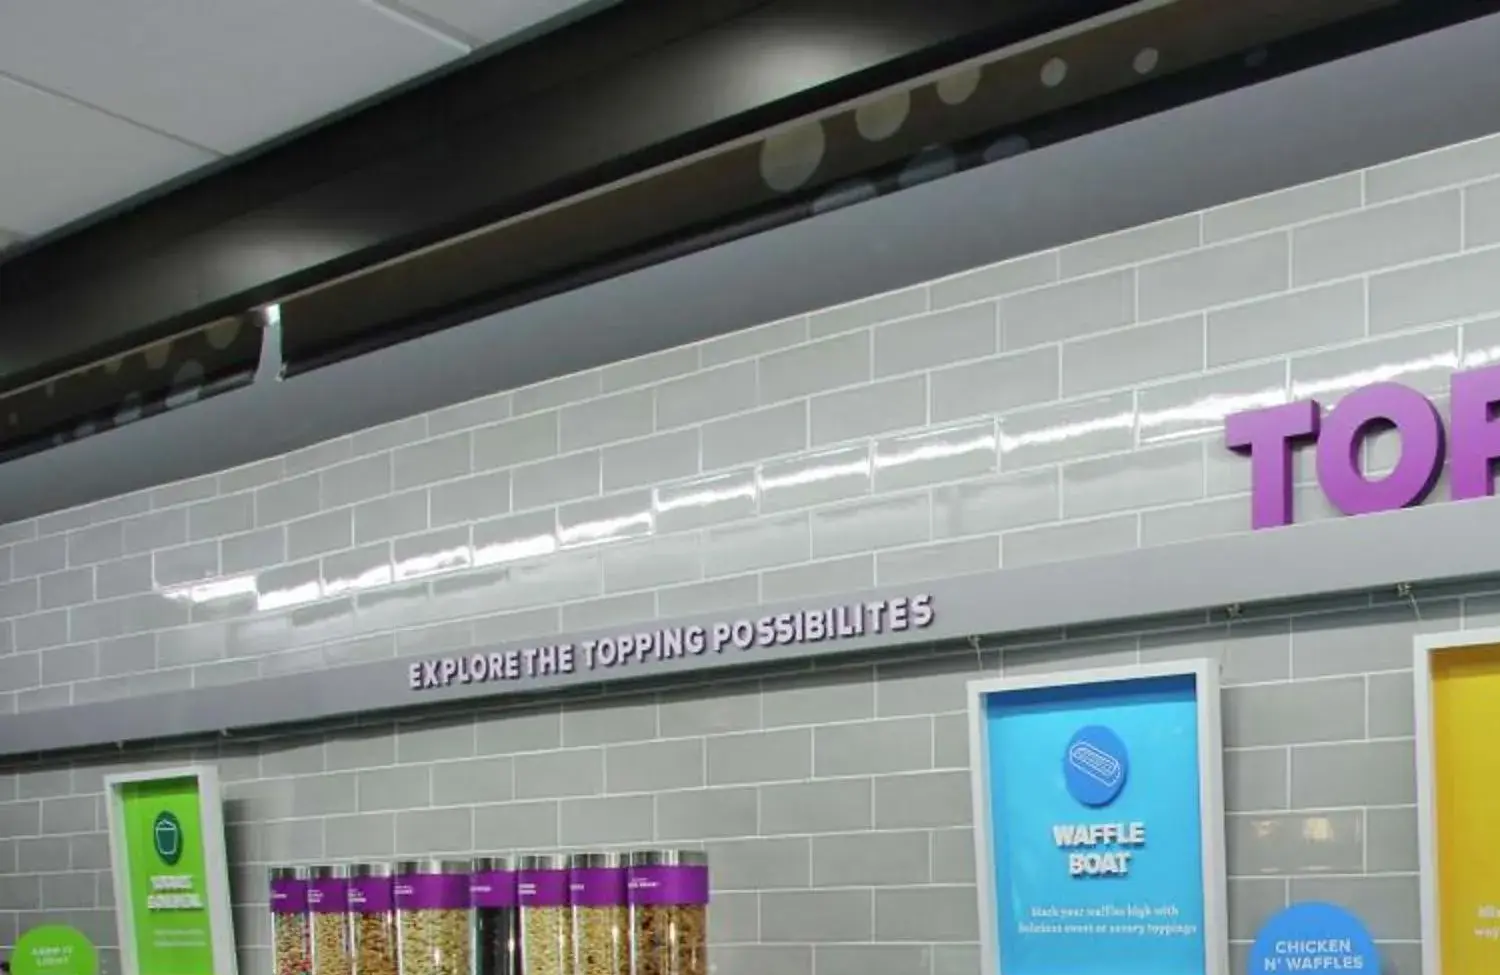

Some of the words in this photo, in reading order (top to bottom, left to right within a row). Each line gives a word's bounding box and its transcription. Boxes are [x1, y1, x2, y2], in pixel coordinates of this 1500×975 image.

[409, 651, 521, 690] EXPLORE
[523, 644, 575, 677] THE
[581, 626, 706, 671] TOPPING
[713, 593, 934, 653] POSSIBILITES
[1052, 821, 1146, 849] WAFFLE
[1069, 850, 1132, 878] BOAT
[1127, 903, 1152, 920] high
[1154, 903, 1180, 917] with
[1148, 922, 1197, 938] toppings
[1275, 938, 1351, 954] CHICKEN
[1264, 957, 1282, 971] N'
[1286, 955, 1364, 971] WAFFLES
